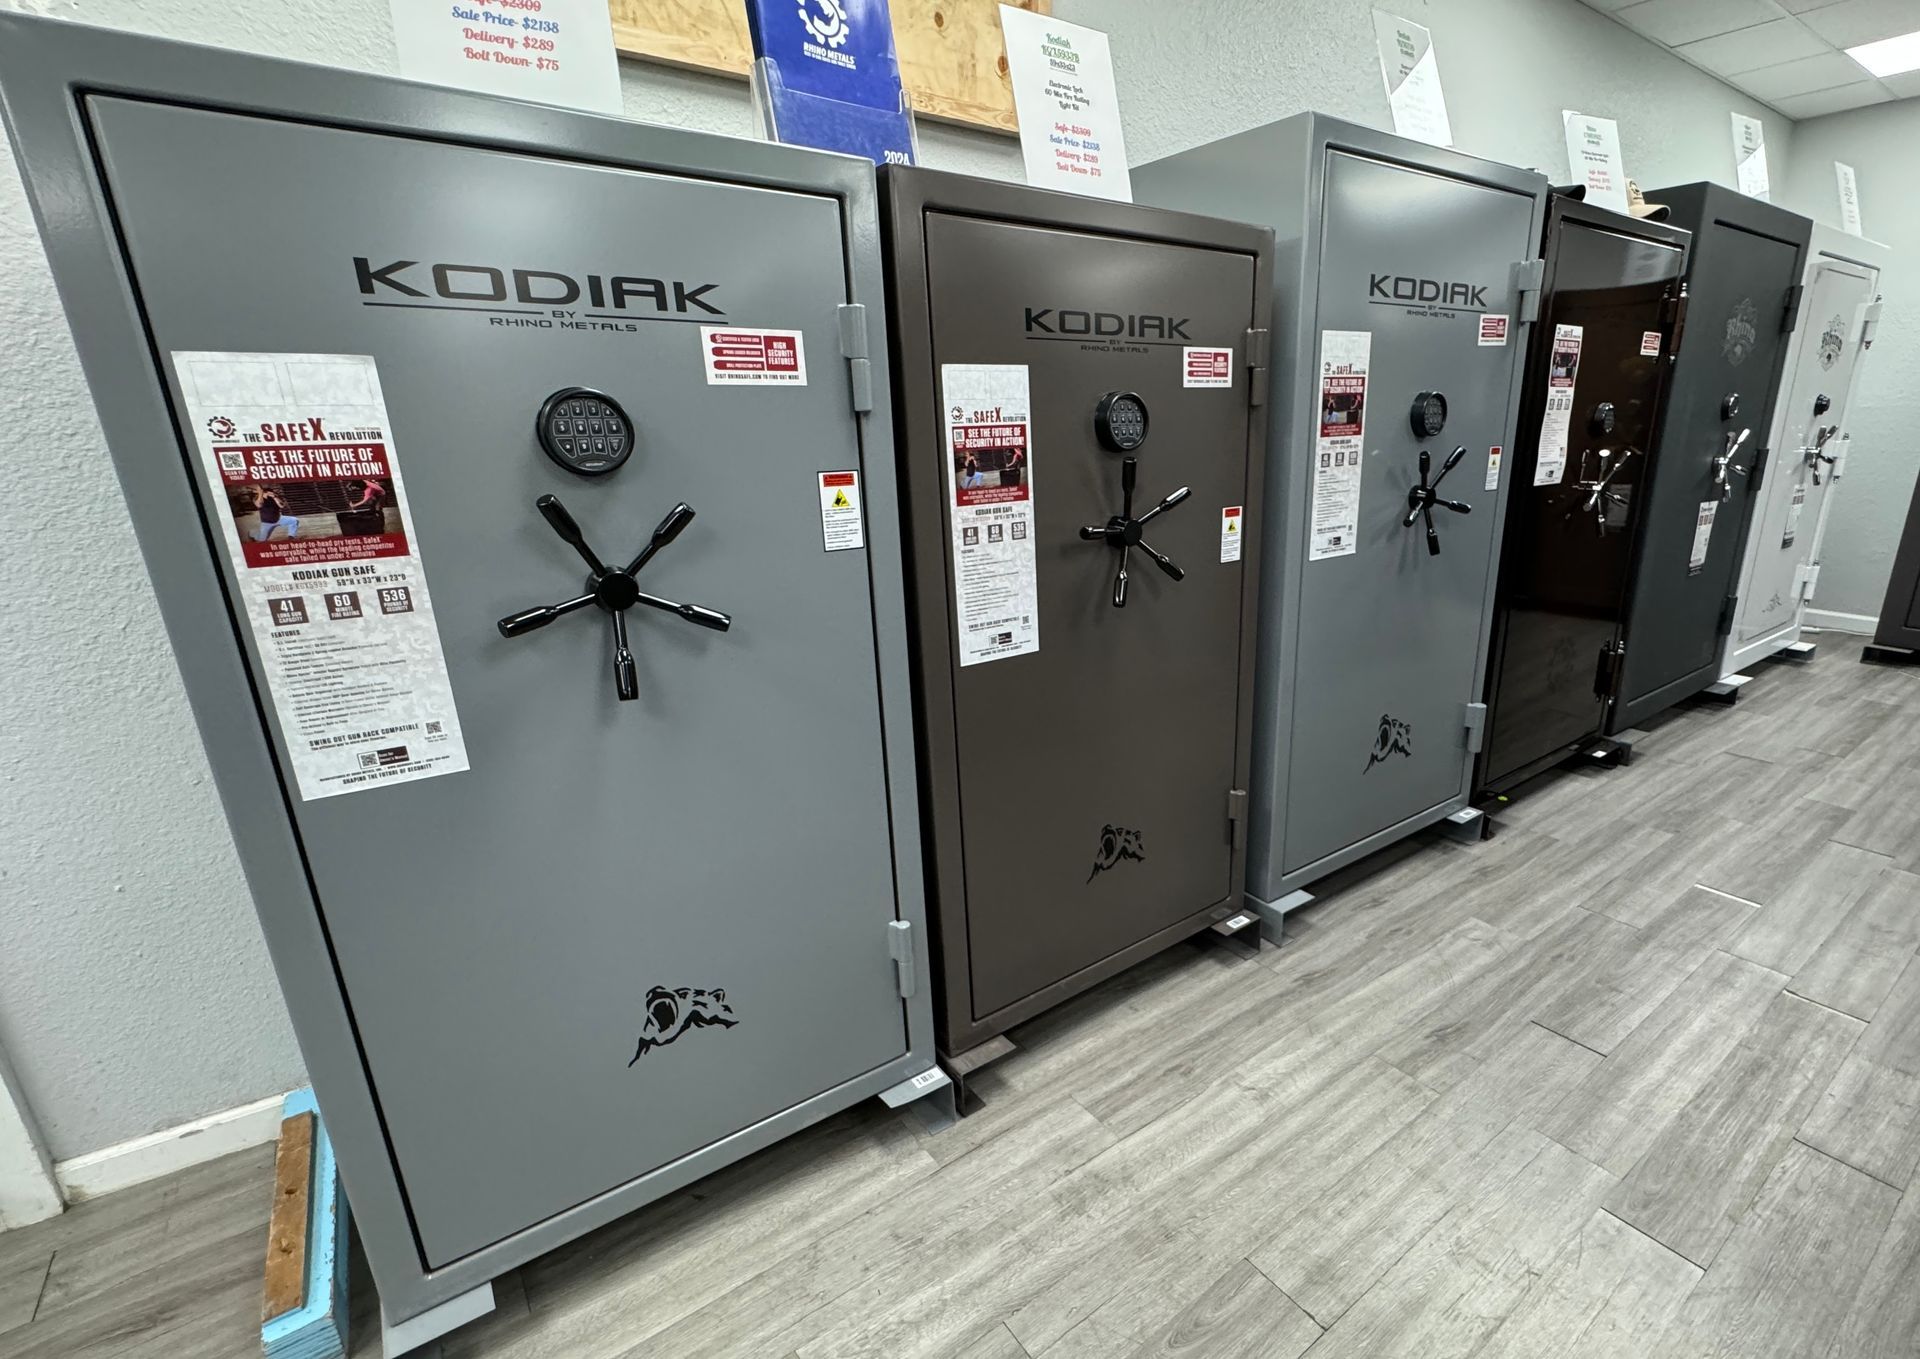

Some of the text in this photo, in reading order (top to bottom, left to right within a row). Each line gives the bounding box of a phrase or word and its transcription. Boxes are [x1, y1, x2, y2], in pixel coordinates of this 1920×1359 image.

[452, 6, 560, 34] Sale Price- $2138
[462, 28, 554, 52] Delivery- $289
[464, 46, 560, 71] Bolt Down- $75
[804, 42, 826, 56] RHINO
[828, 50, 855, 64] METALS
[884, 150, 910, 165] 2024
[353, 256, 726, 315] KODIAK
[1370, 274, 1488, 307] KODIAK
[552, 310, 576, 318] BY
[490, 318, 638, 332] RHINO METALS
[1024, 308, 1192, 340] KODIAK
[768, 350, 793, 358] SECURITY
[768, 358, 794, 366] FEATURES
[974, 407, 1002, 423] SAFEX
[243, 433, 261, 442] THE
[261, 418, 326, 442] SAFEX
[329, 431, 382, 440] REVOLUTION
[968, 427, 1021, 438] SEE THE FUTURE OF
[966, 438, 994, 448] SECURITY
[994, 438, 1001, 446] IN
[253, 448, 374, 464] SEE THE FUTURE OF
[251, 462, 384, 480] SECURITY IN ACTION!
[292, 566, 376, 580] KODIAK GUN SAFE
[334, 594, 351, 606] 60
[383, 589, 406, 602] 536
[280, 600, 295, 612] 41
[310, 737, 332, 746] SWING
[381, 724, 419, 734] COMPATIBLE
[408, 764, 432, 772] SECURITY
